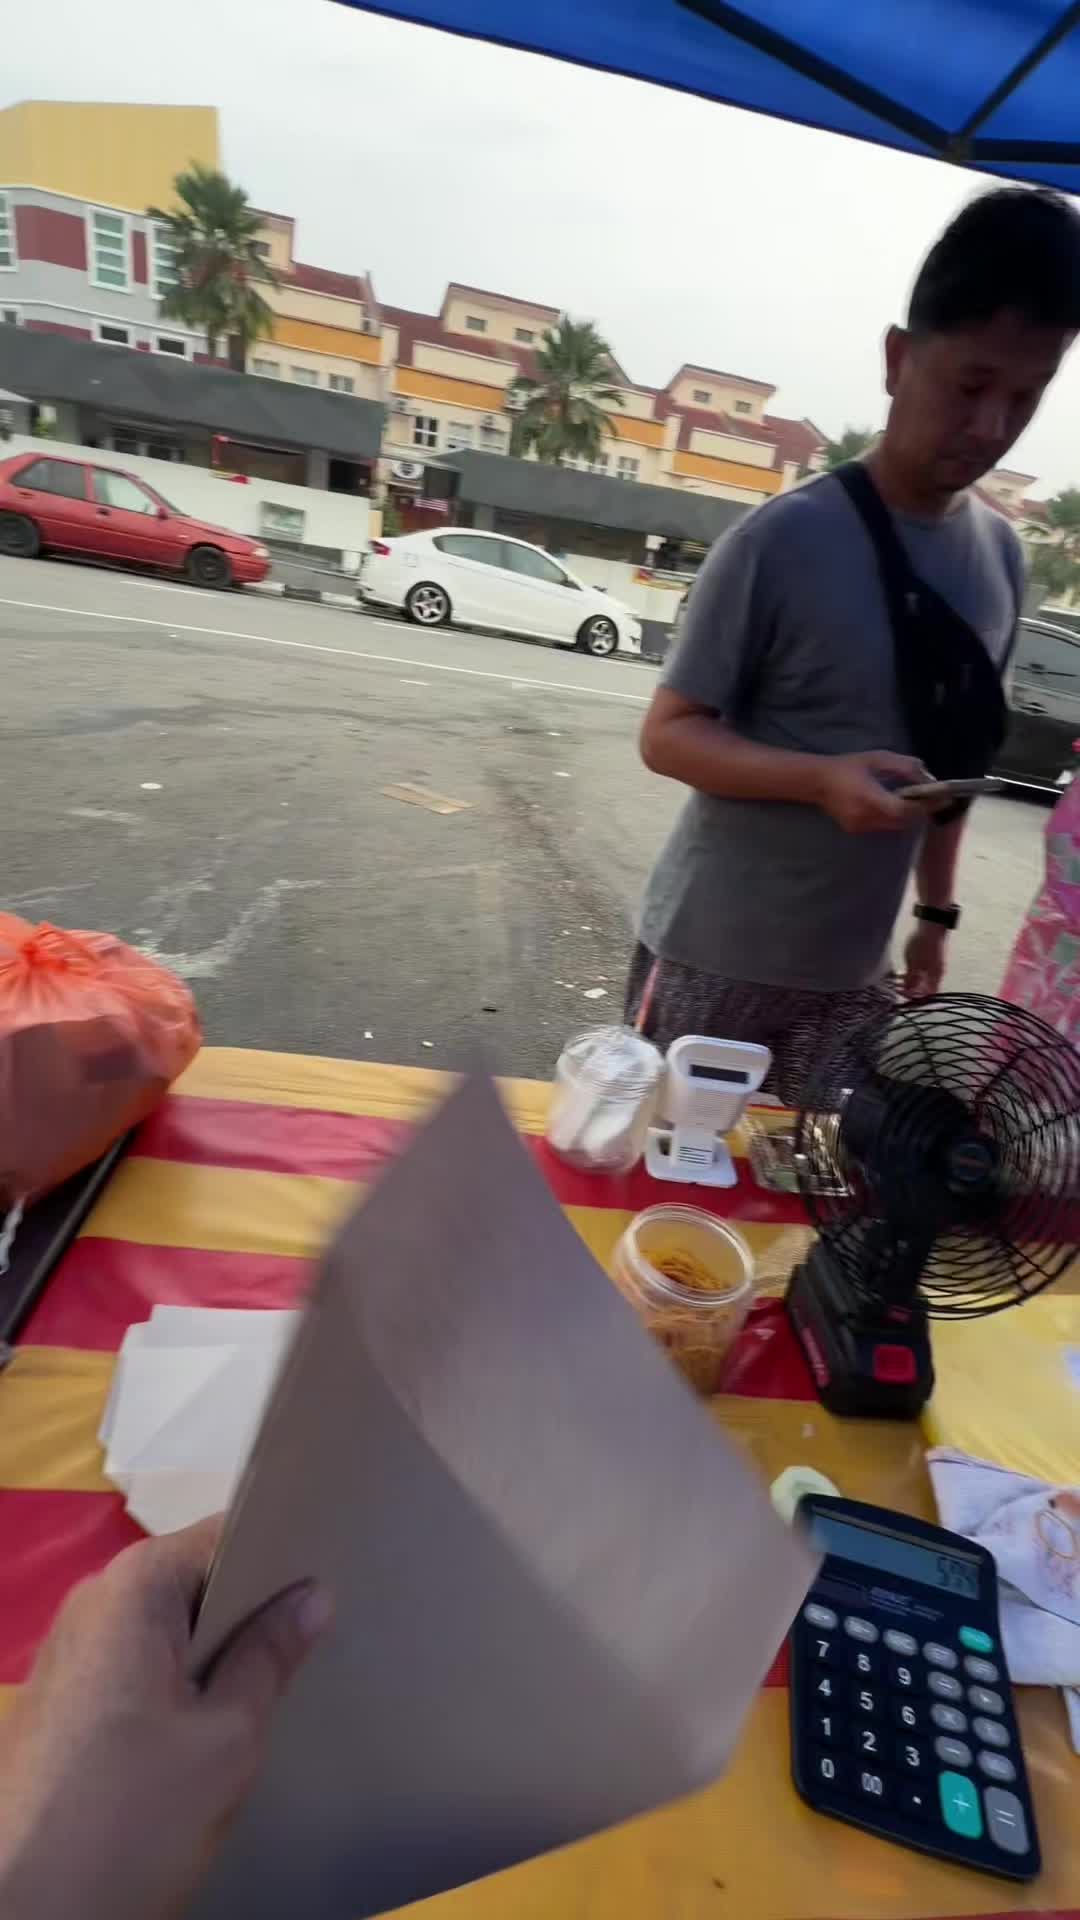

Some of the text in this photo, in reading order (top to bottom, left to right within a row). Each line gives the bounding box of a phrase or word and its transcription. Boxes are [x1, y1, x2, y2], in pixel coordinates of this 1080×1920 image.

[816, 1640, 912, 1686] 7 8 9
[818, 1679, 916, 1725] 4 5 6
[821, 1717, 920, 1767] 1 2 3
[821, 1758, 835, 1779] 0
[862, 1772, 883, 1796] 00
